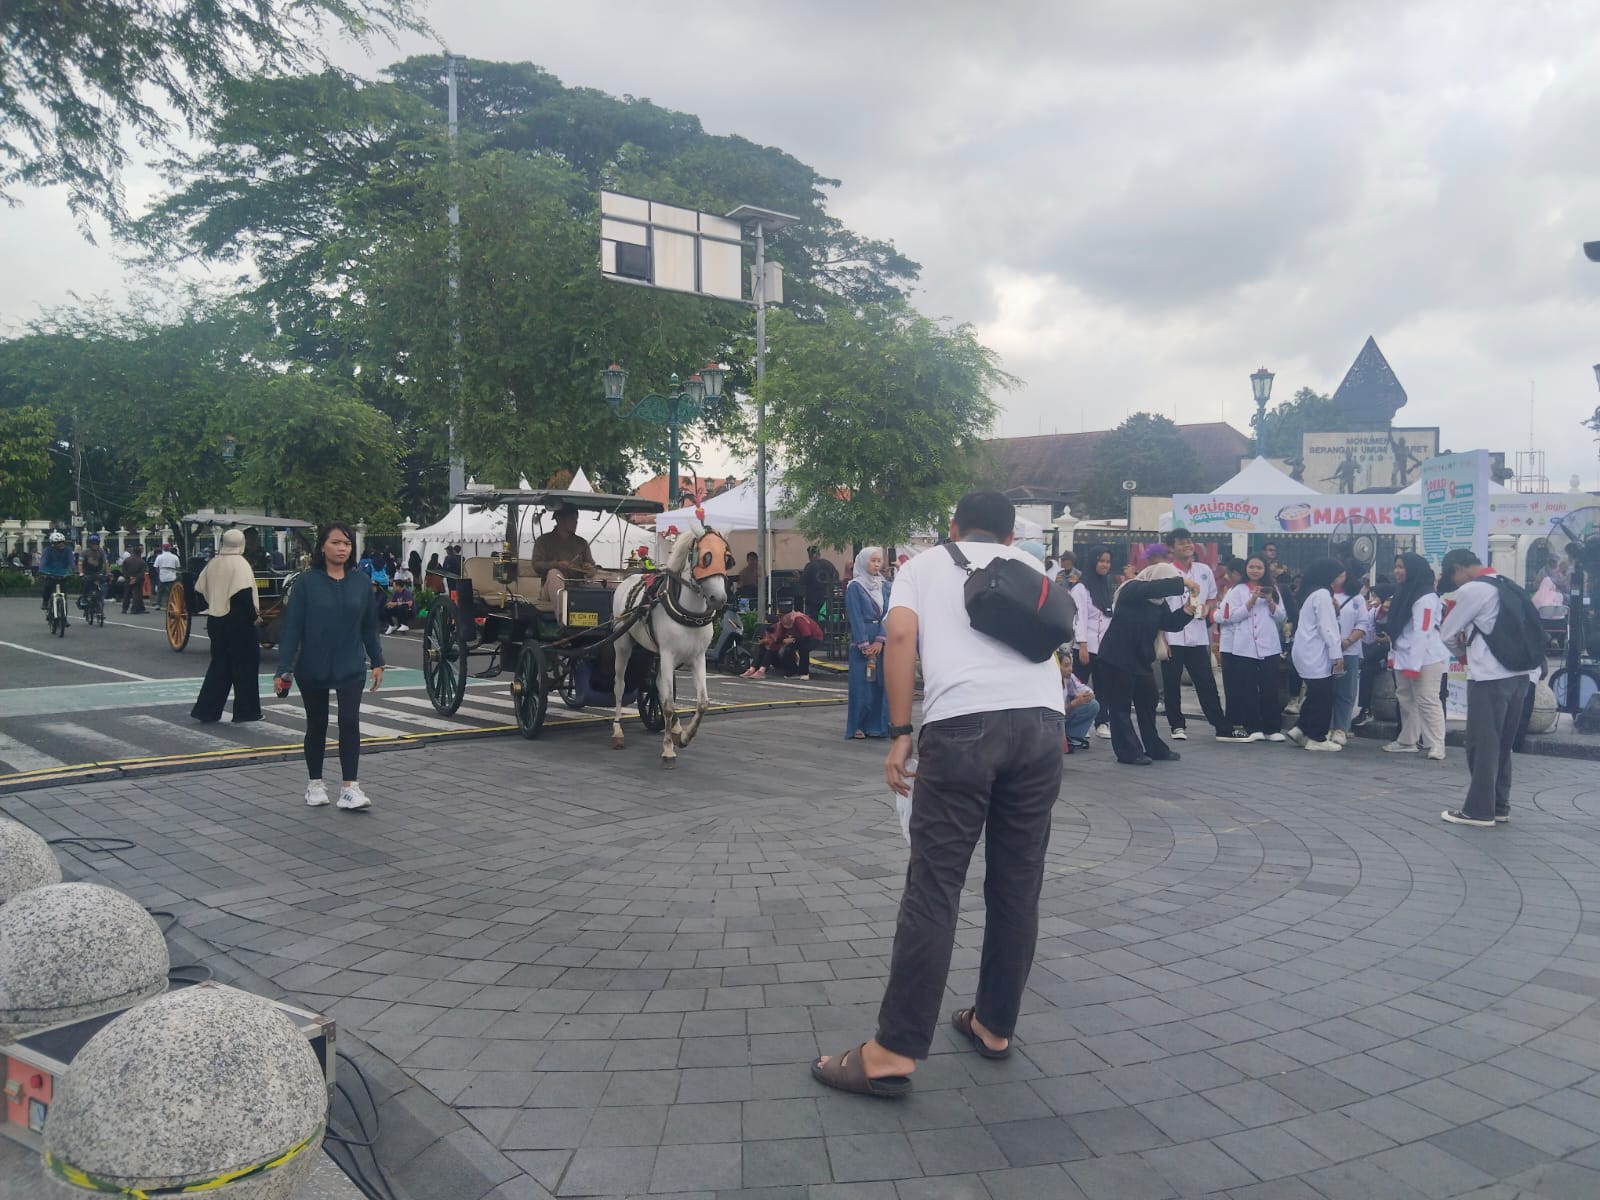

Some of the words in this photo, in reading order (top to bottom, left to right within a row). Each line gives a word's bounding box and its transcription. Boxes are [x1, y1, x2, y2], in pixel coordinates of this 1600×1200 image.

[1346, 437, 1391, 445] MONUMEN
[1361, 446, 1388, 454] UMUM
[1313, 507, 1393, 525] MASAK
